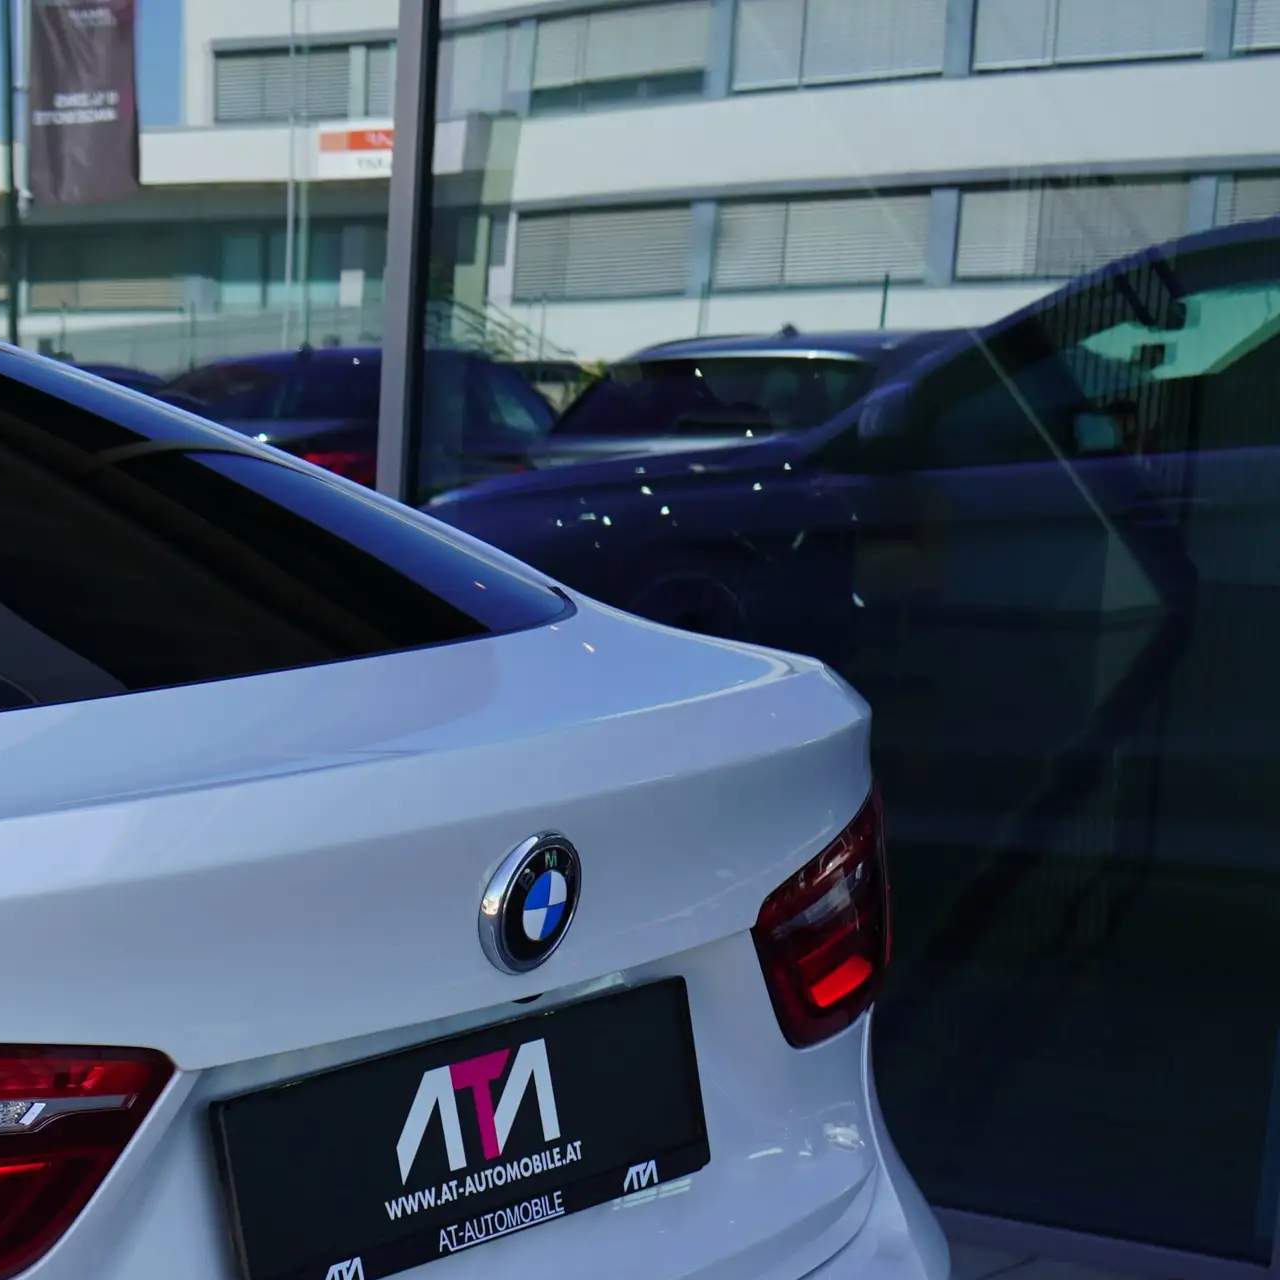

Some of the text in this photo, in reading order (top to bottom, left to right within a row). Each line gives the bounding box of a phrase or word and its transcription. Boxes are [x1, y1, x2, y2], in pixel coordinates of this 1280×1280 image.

[396, 1038, 561, 1186] ATA
[384, 1140, 583, 1221] WWW.AT-AUTOMOBILE.AT
[623, 1159, 659, 1192] ATA
[439, 1191, 564, 1253] AT-AUTOMOBILE
